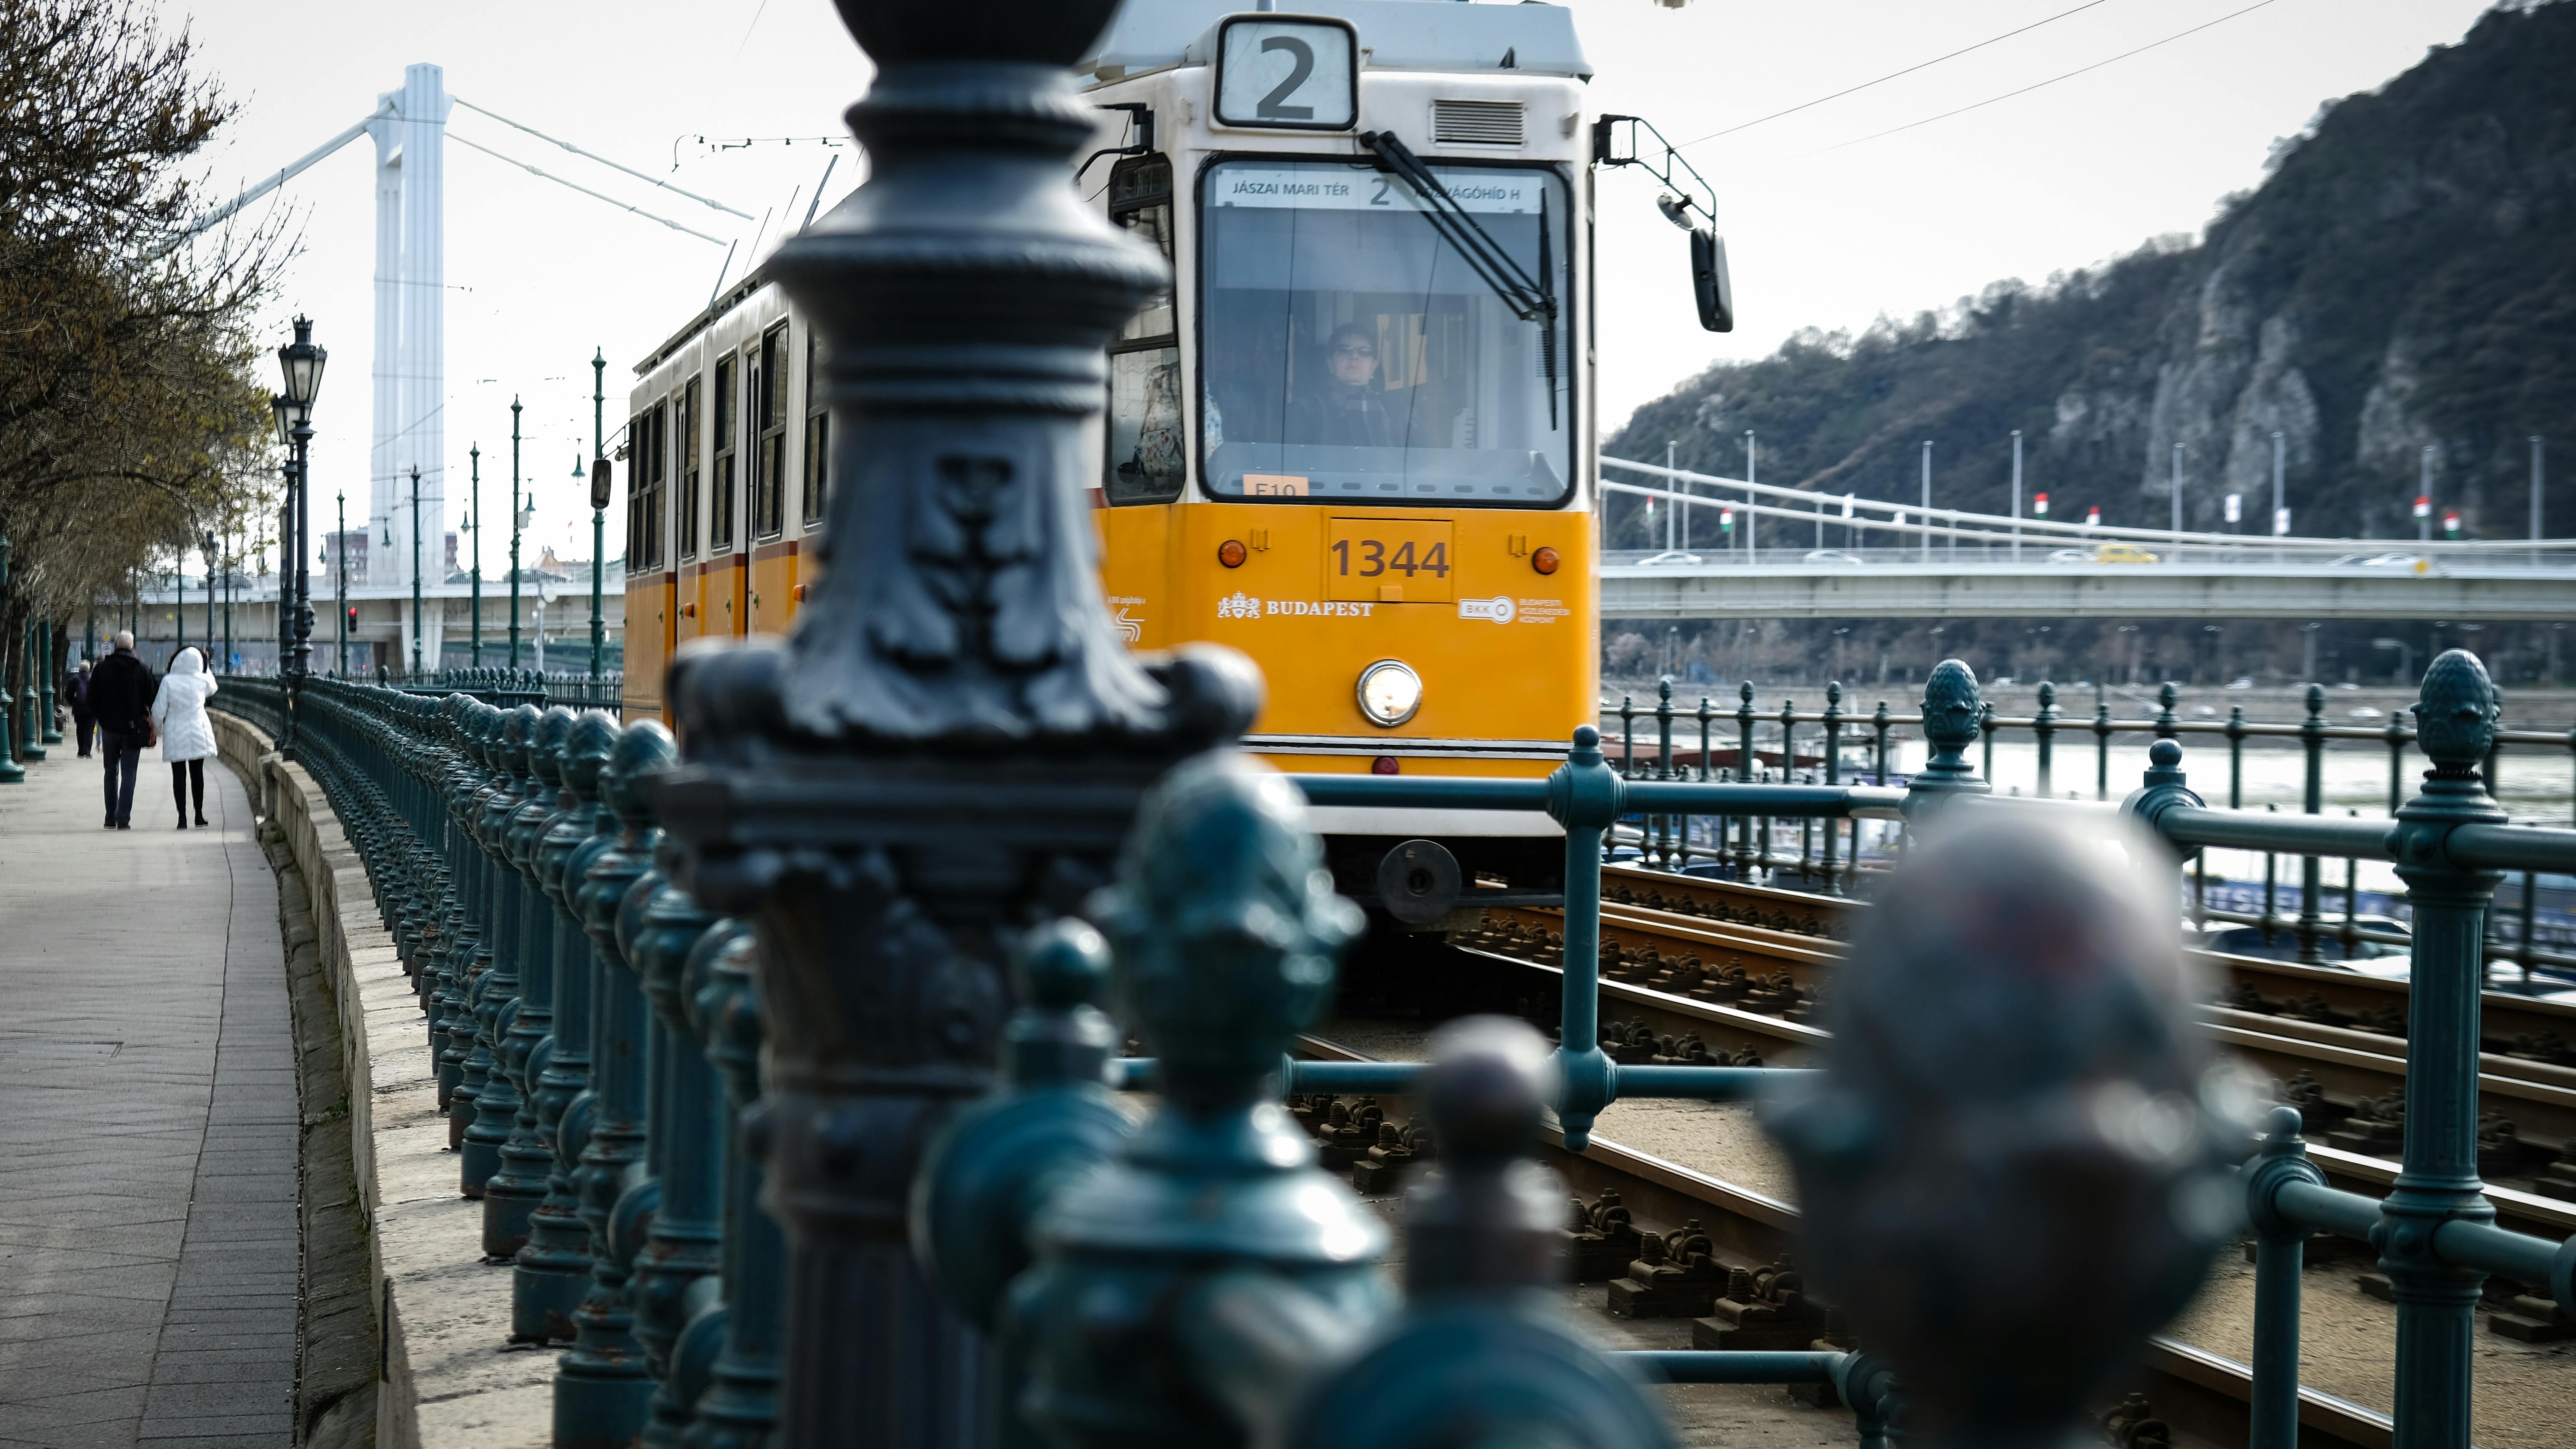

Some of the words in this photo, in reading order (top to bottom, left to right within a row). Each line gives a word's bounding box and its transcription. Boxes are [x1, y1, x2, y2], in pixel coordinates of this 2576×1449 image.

[1256, 36, 1314, 120] 2
[1233, 181, 1278, 194] JÁSZAI
[1283, 184, 1319, 195] MARI
[1324, 182, 1349, 196] TÉR
[1370, 178, 1390, 206] 2
[1510, 189, 1521, 200] H
[1331, 540, 1450, 578] 1344
[1267, 601, 1374, 617] BUDAPEST
[1466, 605, 1491, 613] BKK
